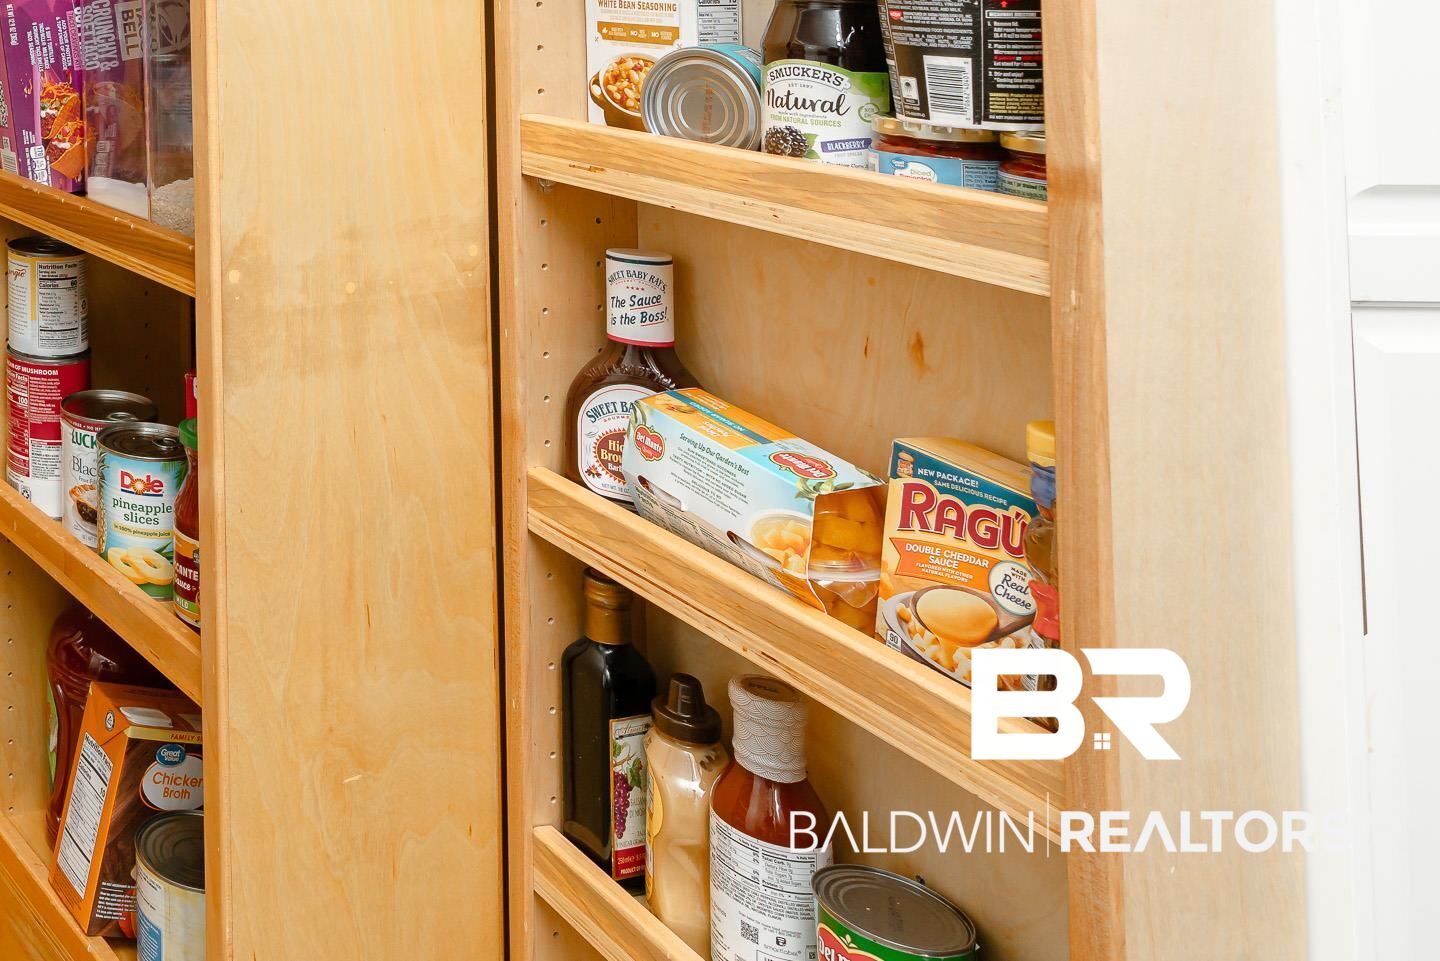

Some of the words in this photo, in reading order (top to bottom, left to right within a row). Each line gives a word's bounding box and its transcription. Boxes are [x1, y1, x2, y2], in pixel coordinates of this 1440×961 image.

[618, 0, 636, 11] BEAN
[637, 1, 677, 12] SEASONING
[121, 9, 137, 56] BELL
[768, 65, 845, 88] SMUCKER'S
[767, 88, 852, 117] Natural
[782, 115, 809, 126] NATURAL
[809, 117, 842, 128] SOURCES
[826, 140, 865, 151] BLACKBERRY
[625, 269, 649, 280] BABY
[610, 296, 626, 309] The
[629, 294, 662, 307] Sauce
[611, 313, 617, 325] is
[620, 312, 637, 325] the
[640, 306, 668, 324] Boss!
[22, 364, 59, 377] MUSHROOM
[17, 396, 28, 404] 100
[585, 401, 618, 424] SWEET
[636, 431, 645, 443] Del
[644, 436, 663, 453] Monte
[679, 432, 698, 451] Serving
[697, 442, 706, 453] Up
[705, 445, 716, 457] Our
[715, 452, 738, 472] Garden's
[737, 465, 750, 476] Best
[119, 469, 165, 495] Dole
[917, 467, 935, 479] NEW
[936, 471, 979, 488] PACKAGE!
[933, 479, 950, 490] SAME
[950, 483, 984, 499] DELICIOUS
[984, 491, 1008, 506] RECIPE
[112, 496, 173, 516] pineapple
[123, 511, 160, 526] slices
[896, 480, 1027, 559] RAGÚ
[118, 525, 133, 535] 100%
[132, 529, 158, 538] pineapple
[158, 530, 171, 538] juice
[905, 543, 942, 557] DOUBLE
[943, 548, 990, 569] CHEDDAR
[928, 555, 959, 570] SAUCE
[915, 562, 941, 573] FLAVORED
[941, 567, 954, 575] WITH
[954, 569, 973, 580] OTHER
[921, 568, 945, 579] NATURAL
[945, 572, 969, 584] FLAVORS
[1010, 566, 1027, 578] MADE
[1011, 572, 1026, 583] WITH
[1001, 573, 1030, 596] Real
[994, 583, 1032, 611] Cheese
[170, 733, 195, 741] FAMILY
[160, 748, 181, 757] Great
[162, 786, 191, 800] Broth
